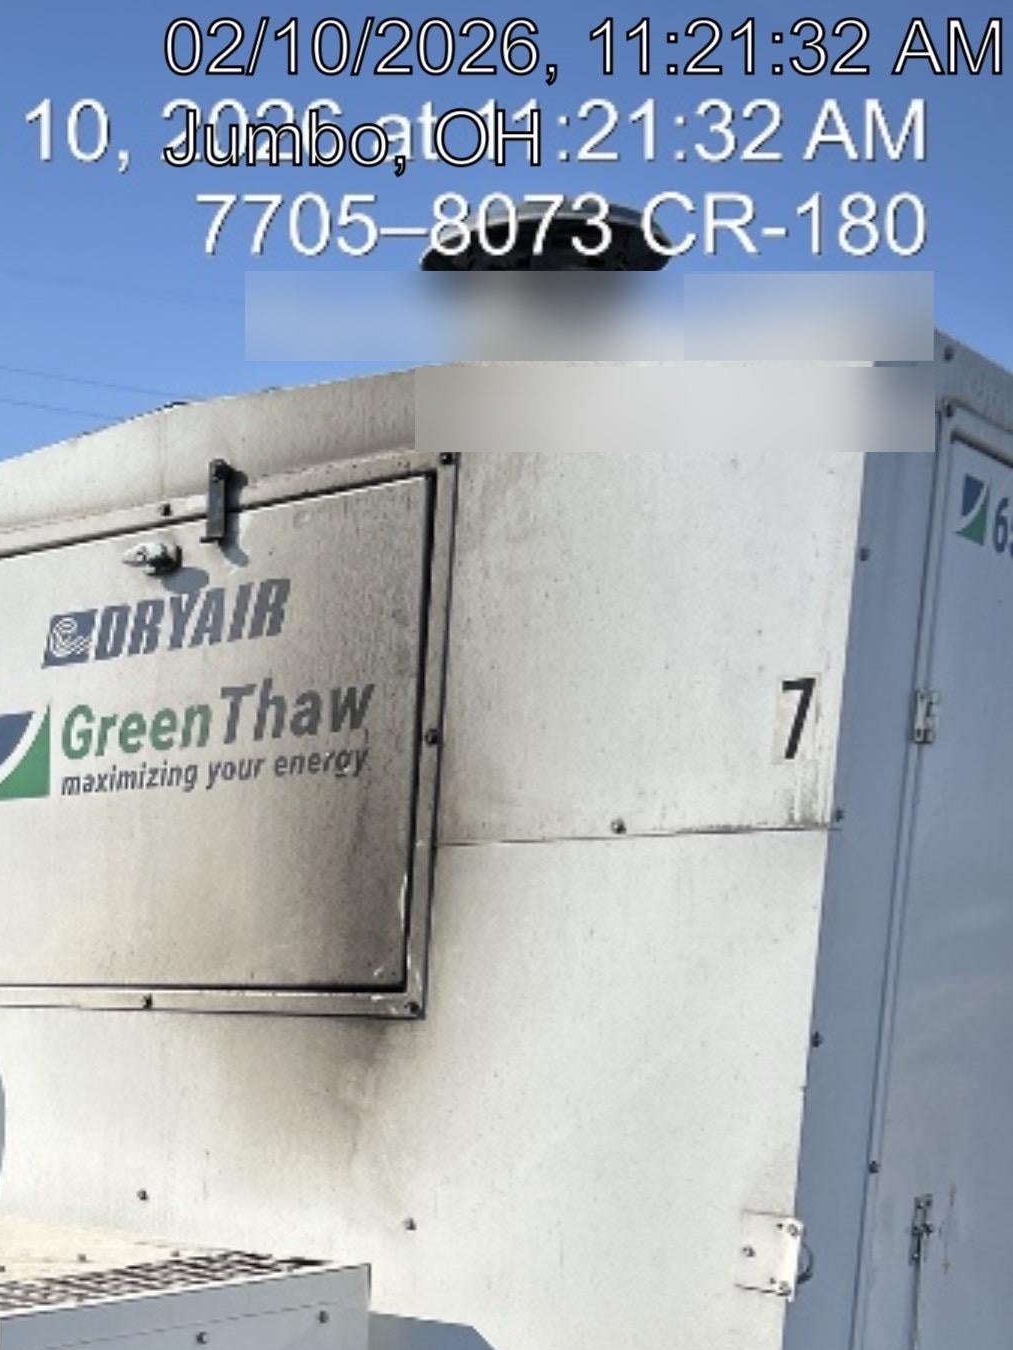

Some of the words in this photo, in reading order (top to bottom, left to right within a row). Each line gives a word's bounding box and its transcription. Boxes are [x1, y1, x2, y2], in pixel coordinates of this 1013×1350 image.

[992, 496, 1013, 560] 6
[91, 577, 291, 662] DRYAIR
[781, 677, 816, 761] 7
[60, 760, 199, 797] maximizing
[205, 757, 266, 791] your
[274, 746, 371, 781] energy
